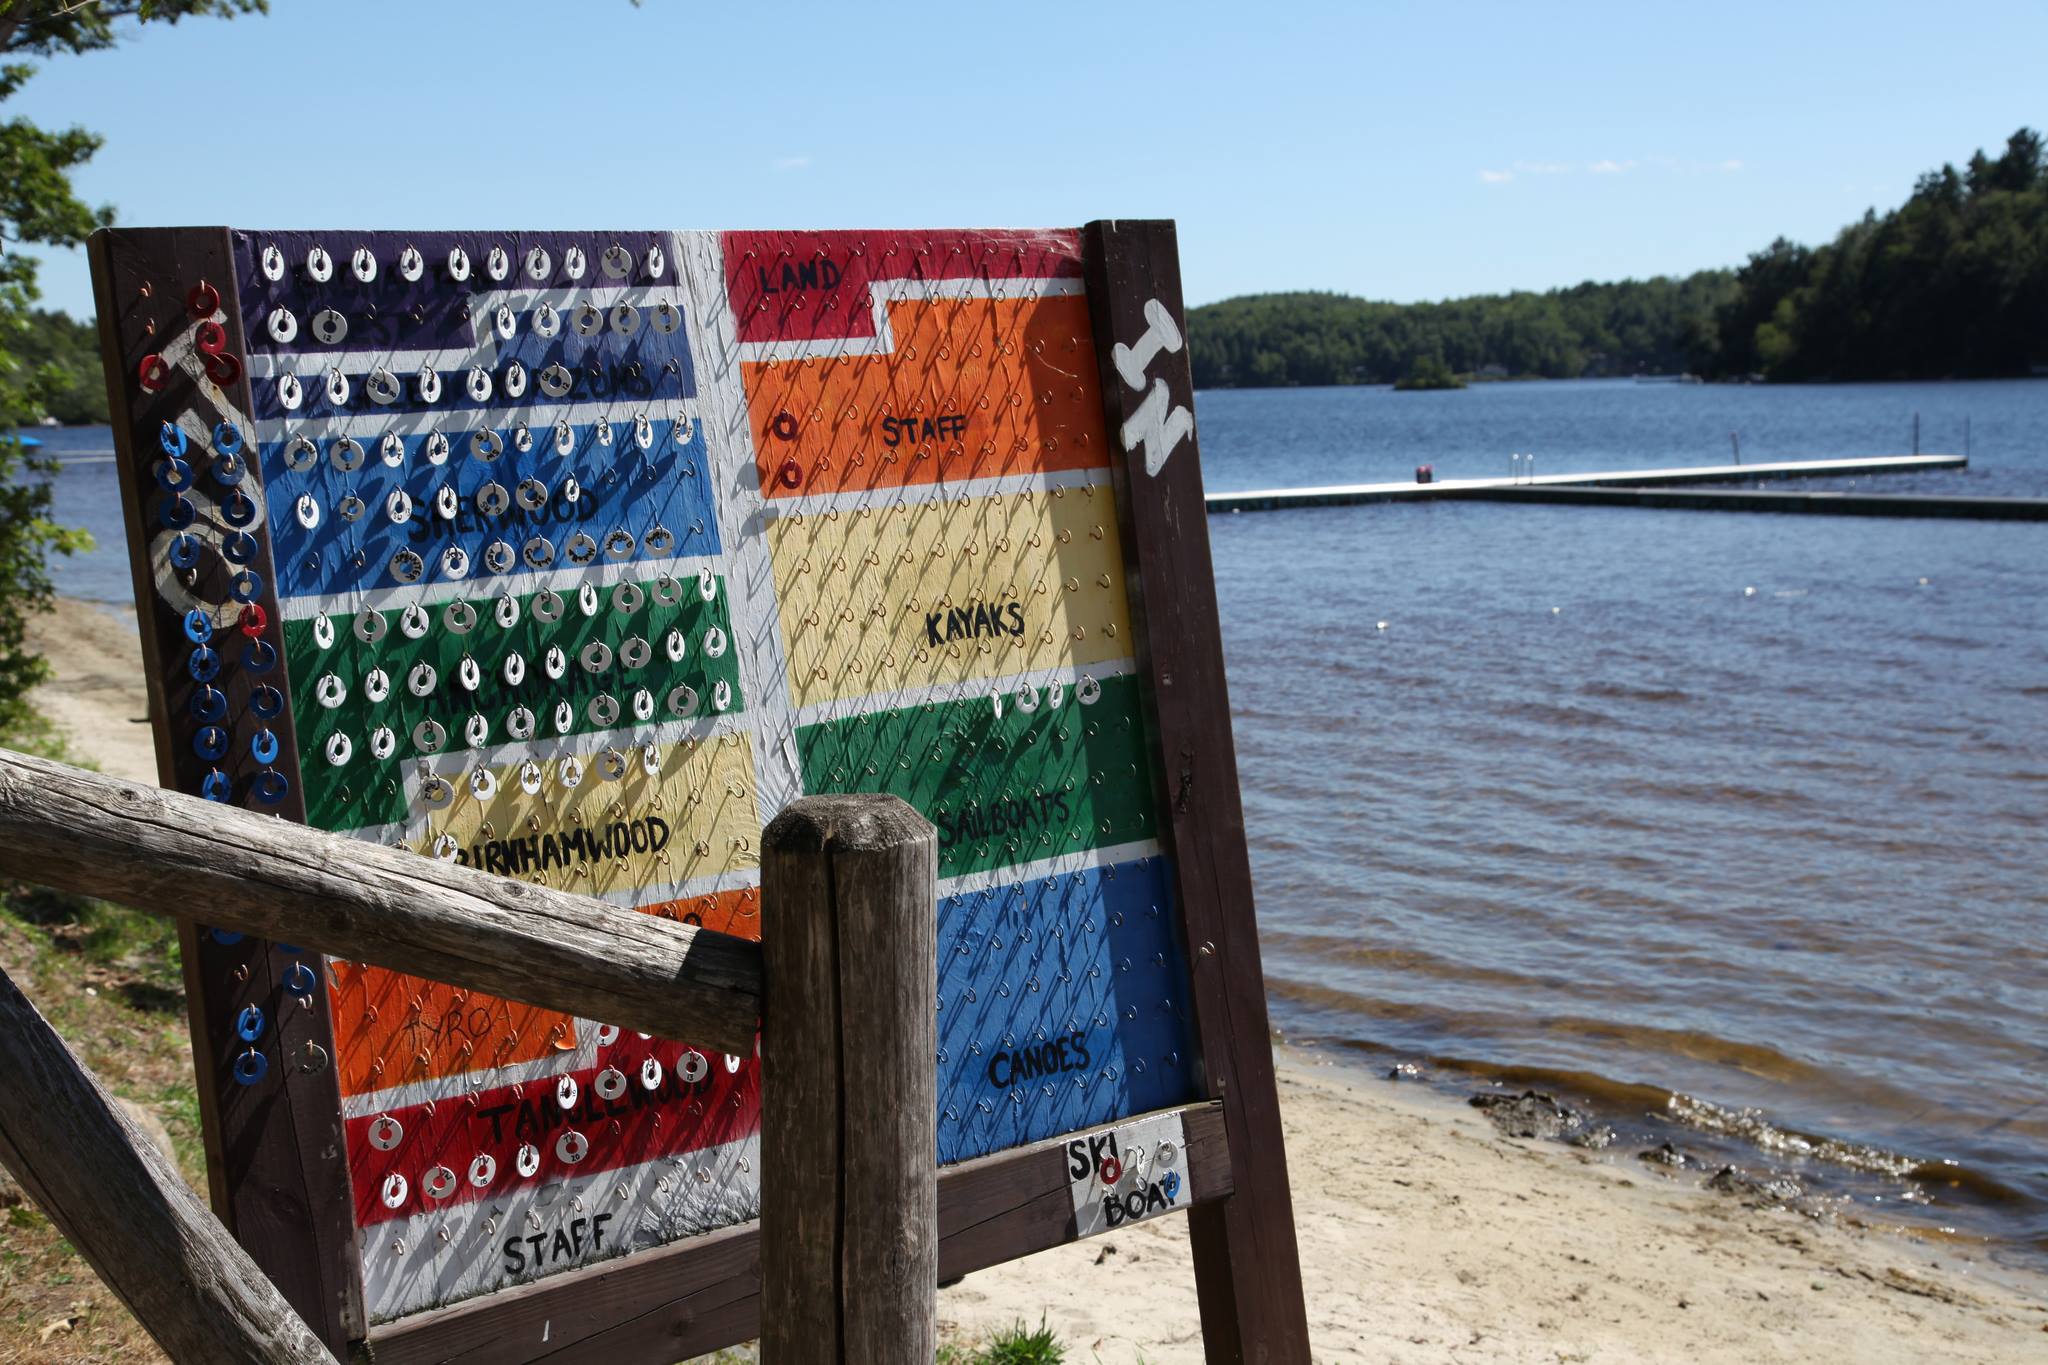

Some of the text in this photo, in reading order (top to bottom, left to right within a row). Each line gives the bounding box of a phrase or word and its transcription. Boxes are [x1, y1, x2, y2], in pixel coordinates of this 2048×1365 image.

[759, 260, 842, 293] LAND
[1112, 298, 1195, 477] IN
[882, 413, 967, 448] STAFF
[926, 602, 1025, 648] KAYAKS
[938, 792, 1069, 848] SAILBOATS
[402, 1007, 491, 1053] TYRO
[989, 1031, 1090, 1089] CANOES
[1069, 1132, 1118, 1180] SKI
[503, 1213, 612, 1274] STAFF
